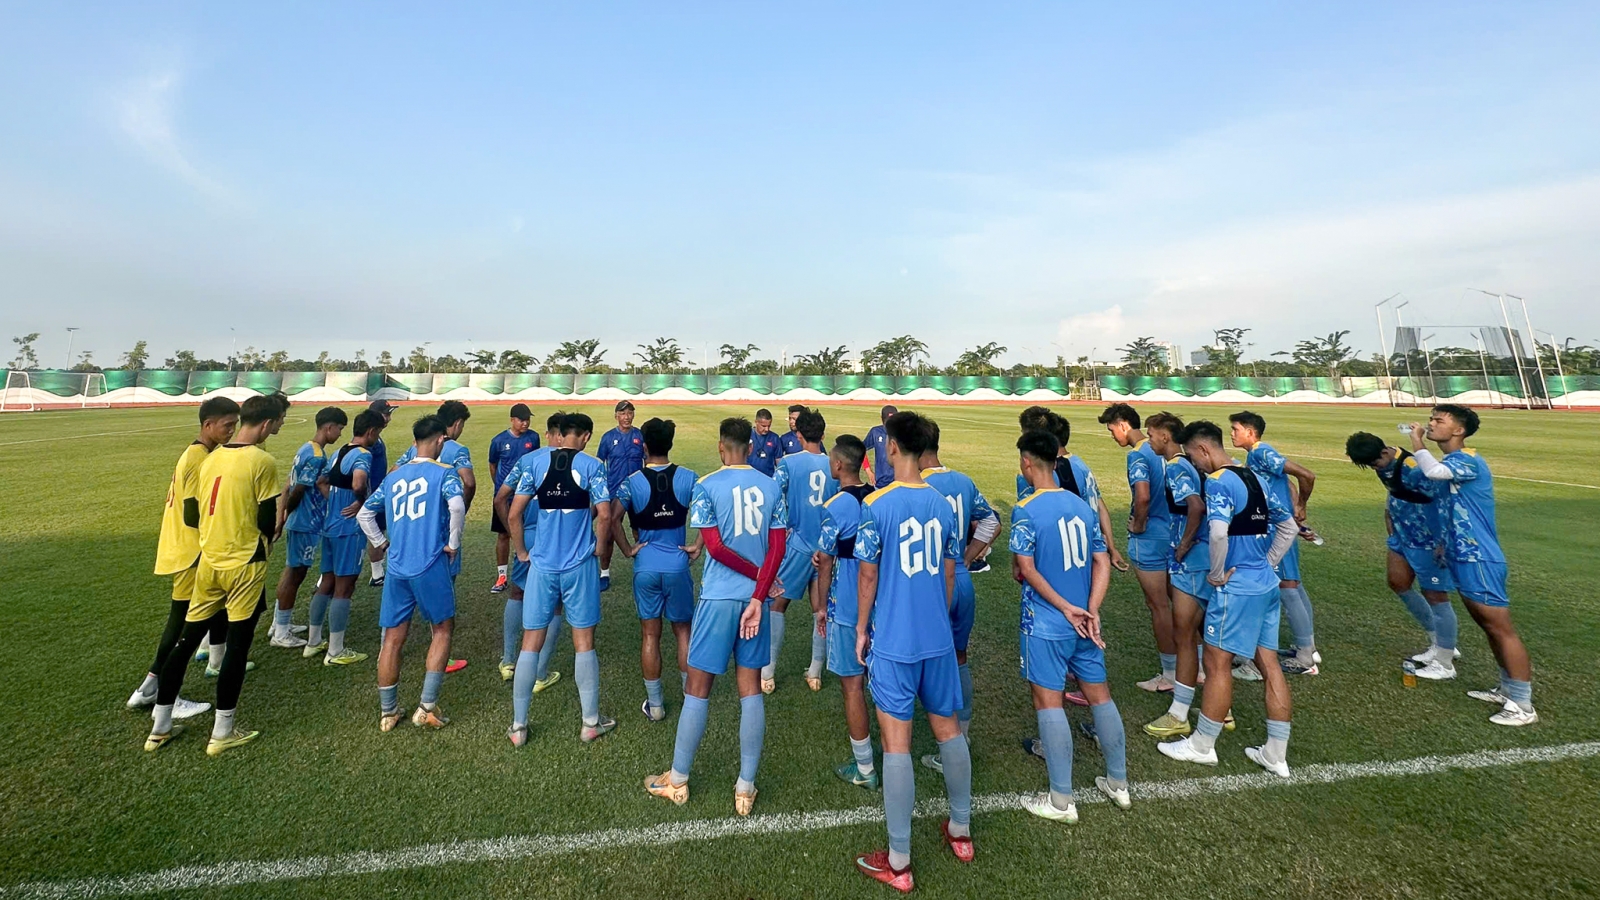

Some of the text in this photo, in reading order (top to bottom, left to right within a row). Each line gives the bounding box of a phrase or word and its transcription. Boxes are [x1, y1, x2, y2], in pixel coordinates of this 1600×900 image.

[209, 475, 222, 516] 1
[392, 476, 428, 523] 22
[732, 485, 764, 537] 18
[808, 469, 827, 507] 9
[899, 516, 942, 579] 20
[1057, 515, 1089, 572] 10
